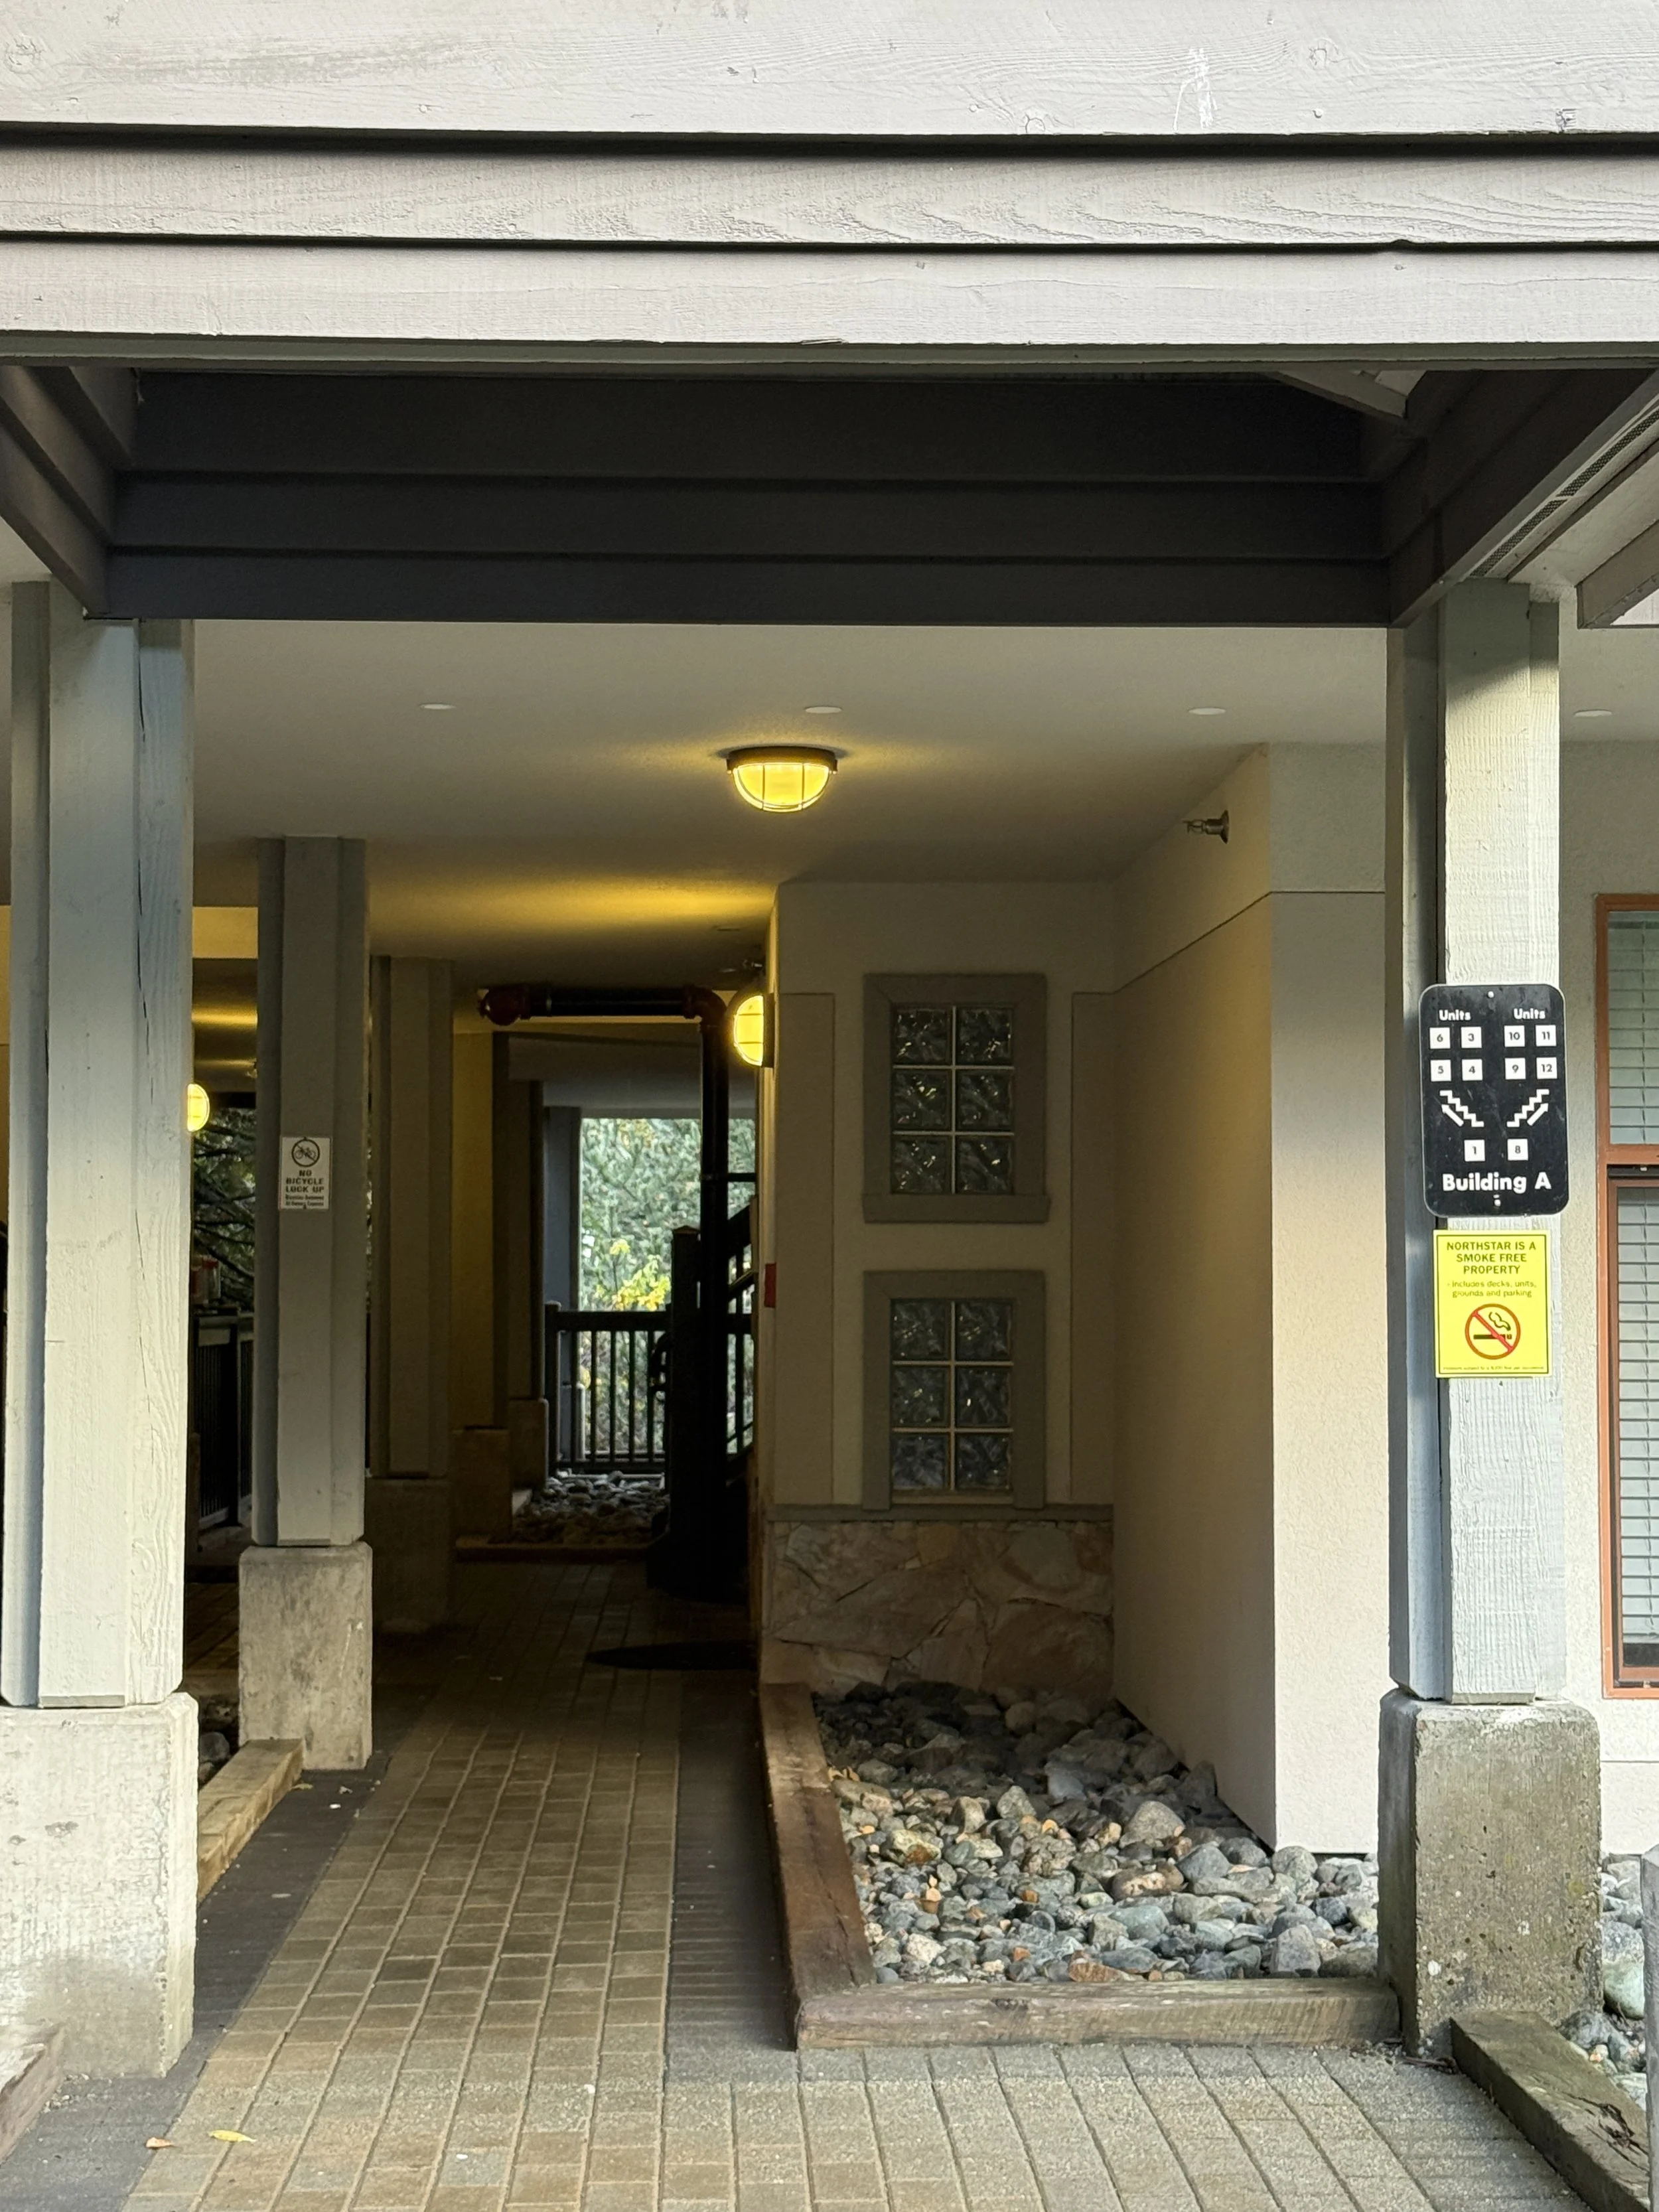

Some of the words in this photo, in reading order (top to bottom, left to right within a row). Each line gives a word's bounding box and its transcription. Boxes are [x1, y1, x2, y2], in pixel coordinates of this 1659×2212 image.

[1439, 1009, 1471, 1021] Units
[1514, 1008, 1546, 1019] Units
[1468, 1033, 1475, 1041] 3
[1541, 1064, 1552, 1072] 12
[1514, 1145, 1521, 1154] 8
[1443, 1172, 1526, 1194] Building
[1535, 1172, 1551, 1190] A
[1447, 1242, 1511, 1250] NORTHSTAR
[1456, 1254, 1495, 1262] SMOKE
[1463, 1266, 1520, 1274] PROPERTY
